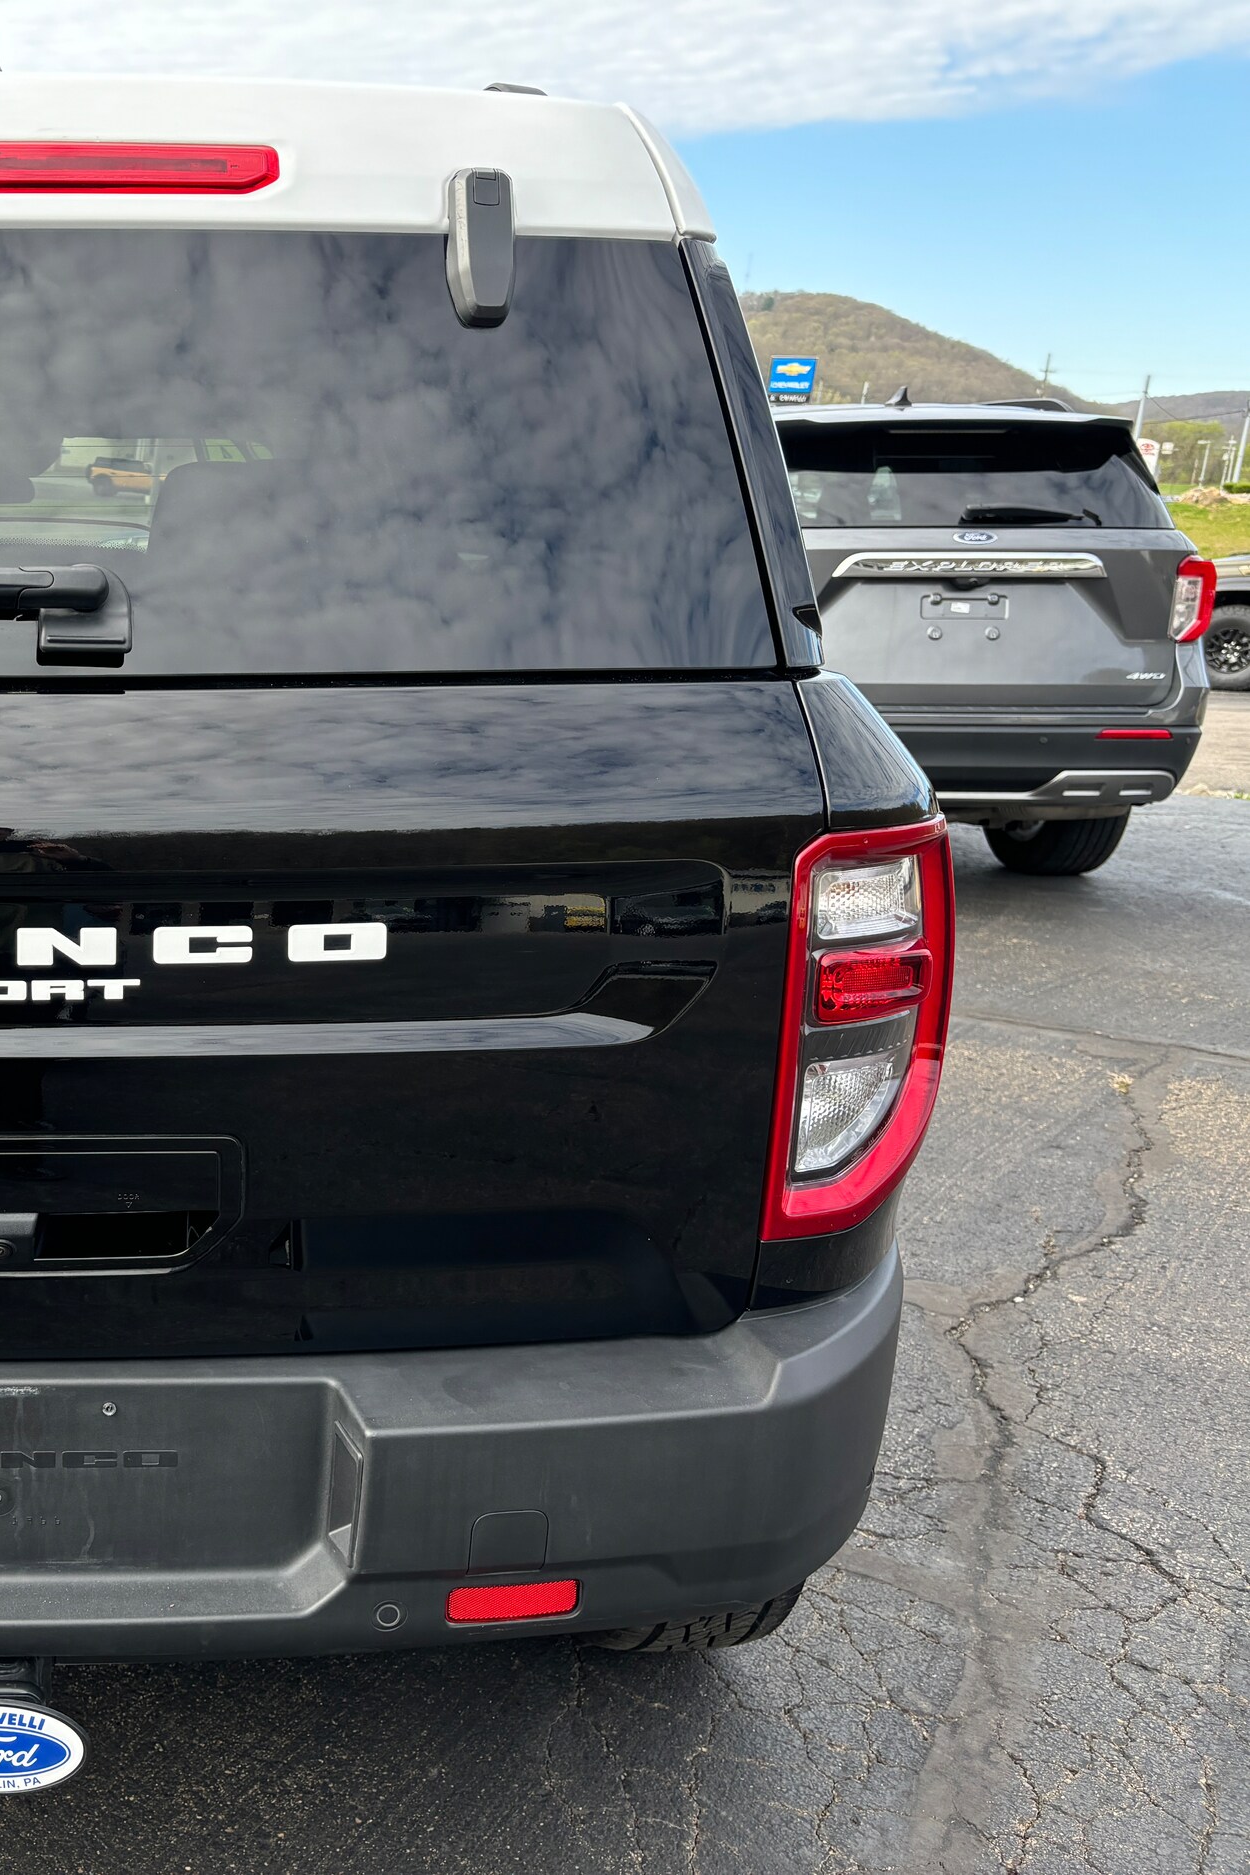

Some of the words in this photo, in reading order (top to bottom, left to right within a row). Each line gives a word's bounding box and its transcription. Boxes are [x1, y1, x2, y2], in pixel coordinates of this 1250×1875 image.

[883, 559, 1066, 573] EXPLORER
[1126, 672, 1166, 680] 4WD
[24, 1777, 41, 1786] PA
